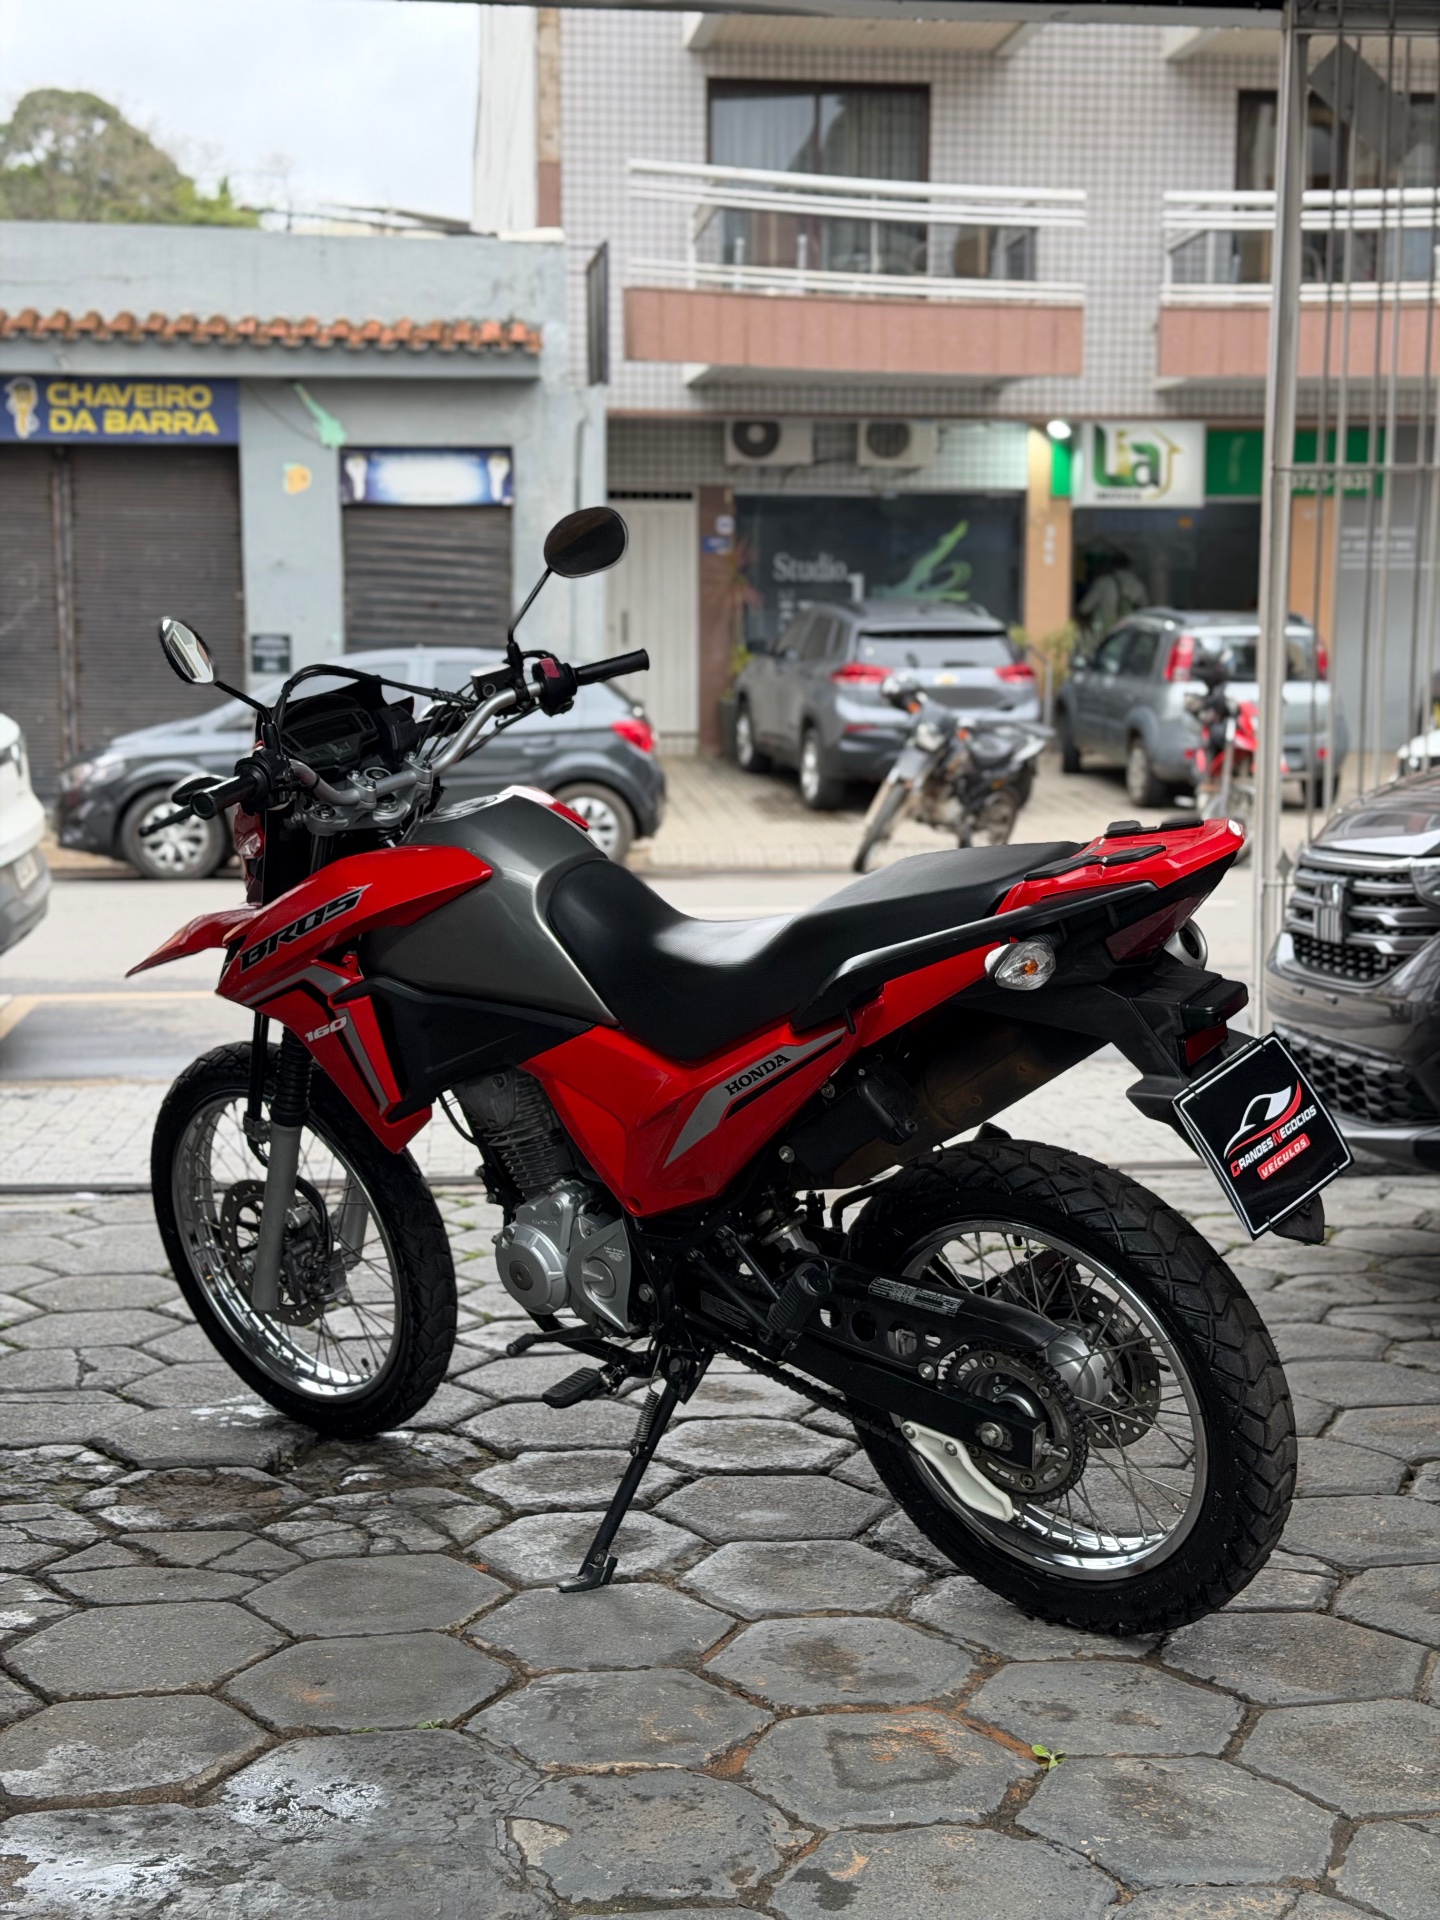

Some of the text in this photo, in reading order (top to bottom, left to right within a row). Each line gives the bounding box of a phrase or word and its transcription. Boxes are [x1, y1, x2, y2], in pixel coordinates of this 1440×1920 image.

[47, 383, 212, 409] CHAVEIRO
[49, 408, 219, 435] DA BARRA
[773, 551, 848, 582] Studio
[239, 883, 372, 973] BROS
[304, 1016, 347, 1042] 160
[724, 1053, 791, 1096] HONDA
[1261, 1138, 1307, 1176] VEÍCULOS
